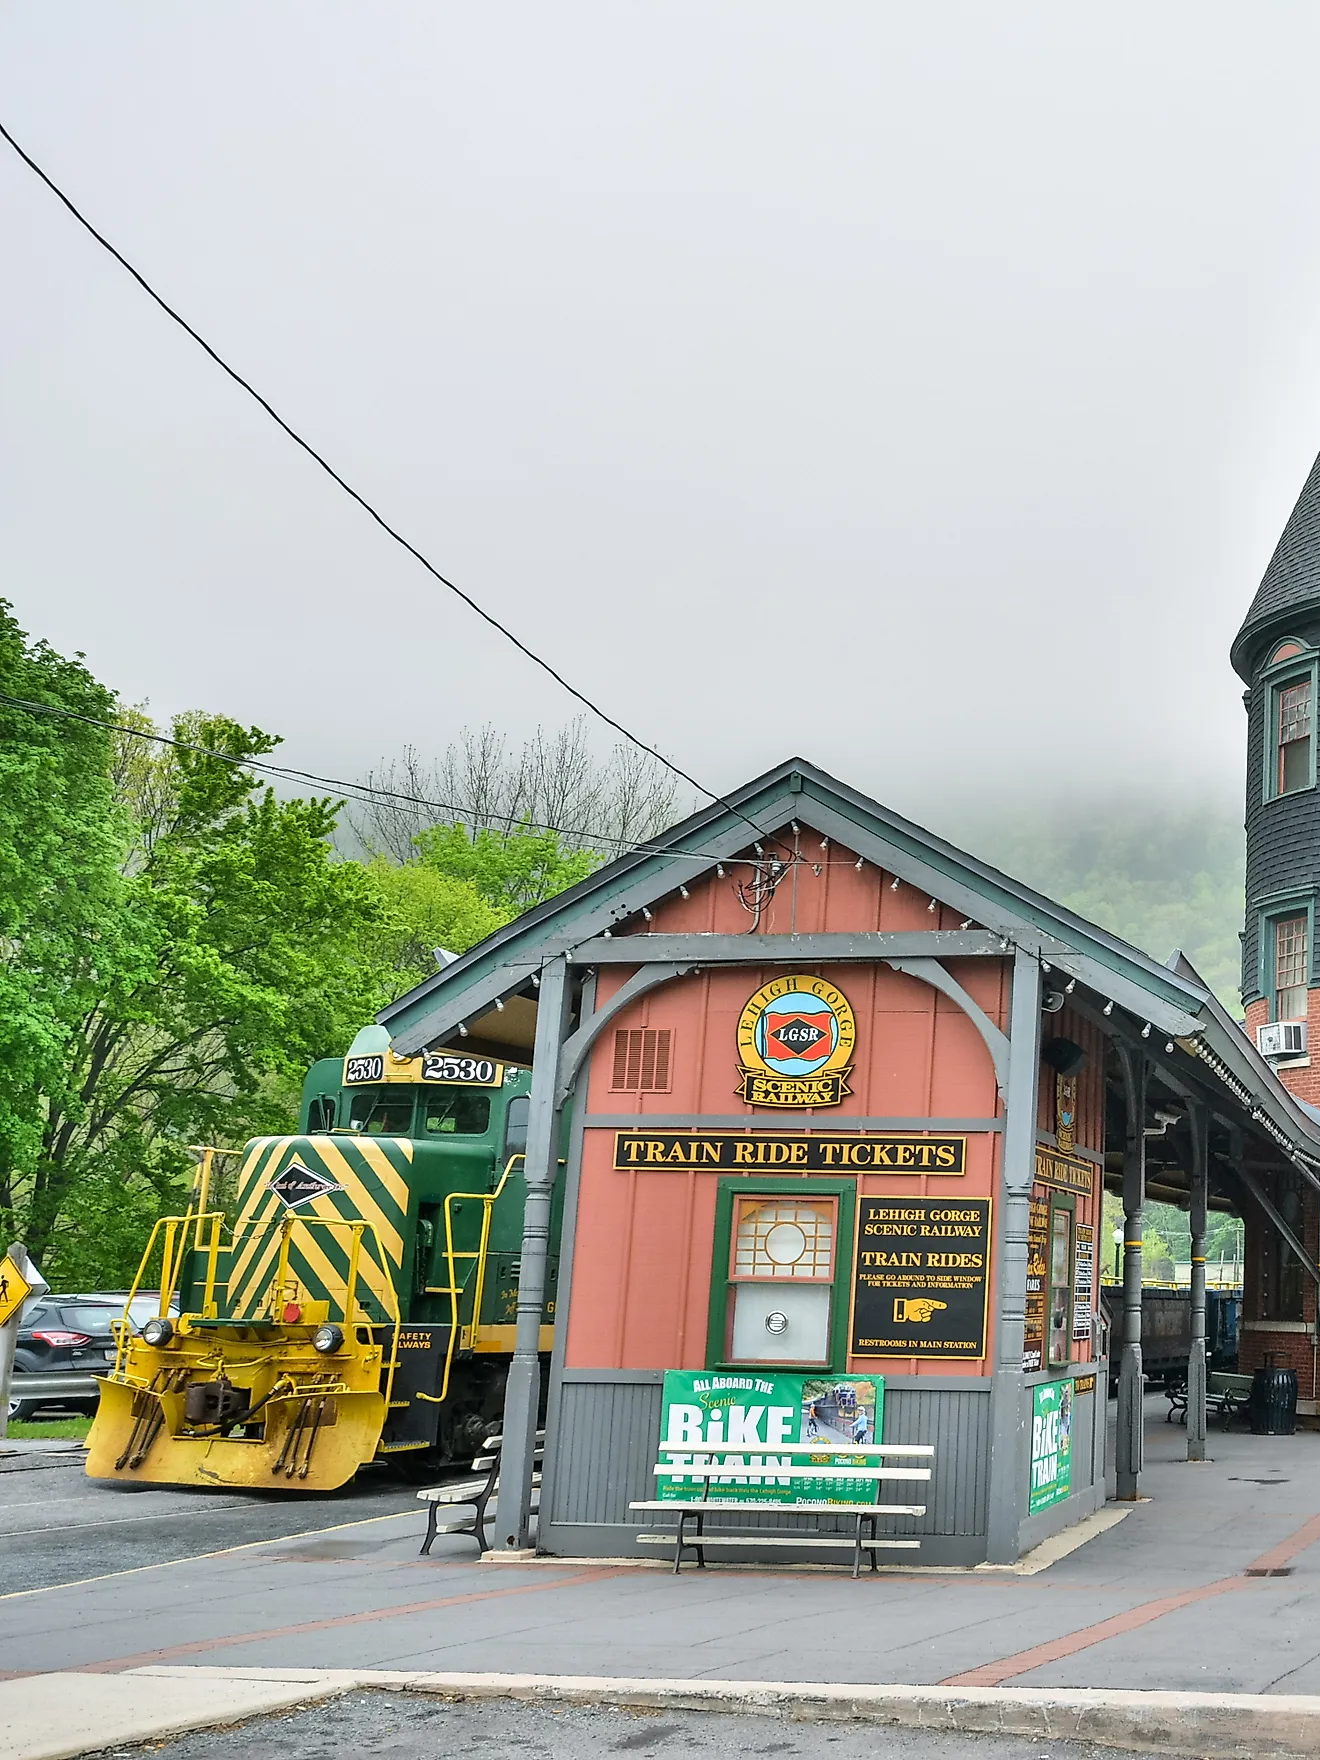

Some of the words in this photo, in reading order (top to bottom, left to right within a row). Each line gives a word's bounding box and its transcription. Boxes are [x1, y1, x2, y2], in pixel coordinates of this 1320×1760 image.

[740, 977, 798, 1047] LEHIGH
[811, 980, 853, 1048] GORGE
[778, 1027, 819, 1042] LGSR
[347, 1057, 382, 1082] 2530
[424, 1056, 494, 1082] 2530
[752, 1078, 833, 1093] SCENIC
[750, 1090, 836, 1104] RAILWAY
[623, 1140, 724, 1164] TRAIN
[731, 1142, 809, 1165] RIDE
[818, 1143, 956, 1168] TICKETS
[868, 1208, 927, 1221] LEHIGH
[929, 1209, 981, 1222] GORGE
[864, 1223, 917, 1236] SCENIC
[919, 1225, 983, 1237] RAILWAY
[861, 1251, 923, 1267] TRAIN
[926, 1252, 983, 1268] RIDES
[859, 1273, 885, 1281] PLEASE
[391, 1341, 432, 1350] LWAYS
[859, 1338, 908, 1348] RESTROOMS
[909, 1340, 919, 1348] IN
[919, 1340, 942, 1349] MAIN
[943, 1341, 978, 1349] STATION
[693, 1378, 711, 1393] ALL
[711, 1376, 754, 1390] ABOARD
[754, 1378, 775, 1395] THE
[699, 1391, 737, 1410] Scenic
[665, 1453, 793, 1486] TRAIN
[1031, 1453, 1059, 1489] TRAIN
